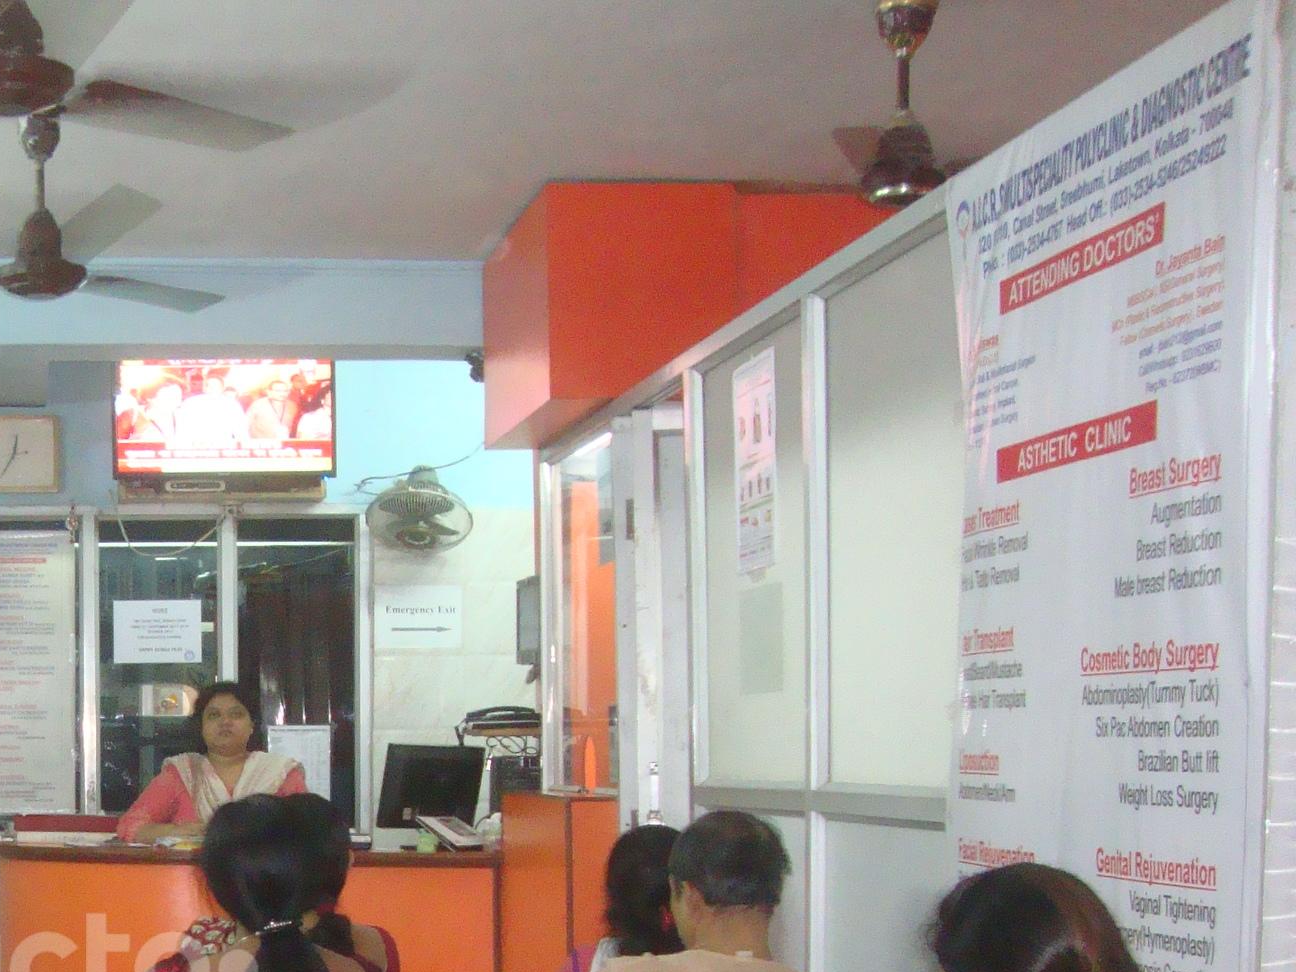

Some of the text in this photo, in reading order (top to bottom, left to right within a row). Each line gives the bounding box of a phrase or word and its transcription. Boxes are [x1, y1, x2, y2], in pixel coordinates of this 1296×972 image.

[1074, 107, 1130, 173] POLYCLINIC
[1140, 62, 1204, 138] DIAGNOSTIC
[1008, 251, 1080, 306] ATTENDING
[1017, 415, 1132, 472] ASTHETIC CLINIC
[1129, 453, 1222, 495] Breast Surgery
[977, 499, 1020, 530] Treatment
[1150, 492, 1222, 528] Augmentation
[1136, 528, 1222, 562] Breast Reduction
[1114, 563, 1222, 599] Male breast Reduction
[385, 605, 456, 615] Emergency Exit
[1080, 639, 1220, 674] Cosmetic Body Surgery
[1189, 678, 1220, 707] Tuck)
[1095, 714, 1220, 738] Six Pac Abdomen Creation
[1137, 750, 1220, 773] Brazilian Butt lift
[1118, 783, 1219, 815] Weight Loss Surgery
[1096, 847, 1217, 887] Genital Rejuvenation
[1128, 889, 1217, 930] Vaginal Tightening
